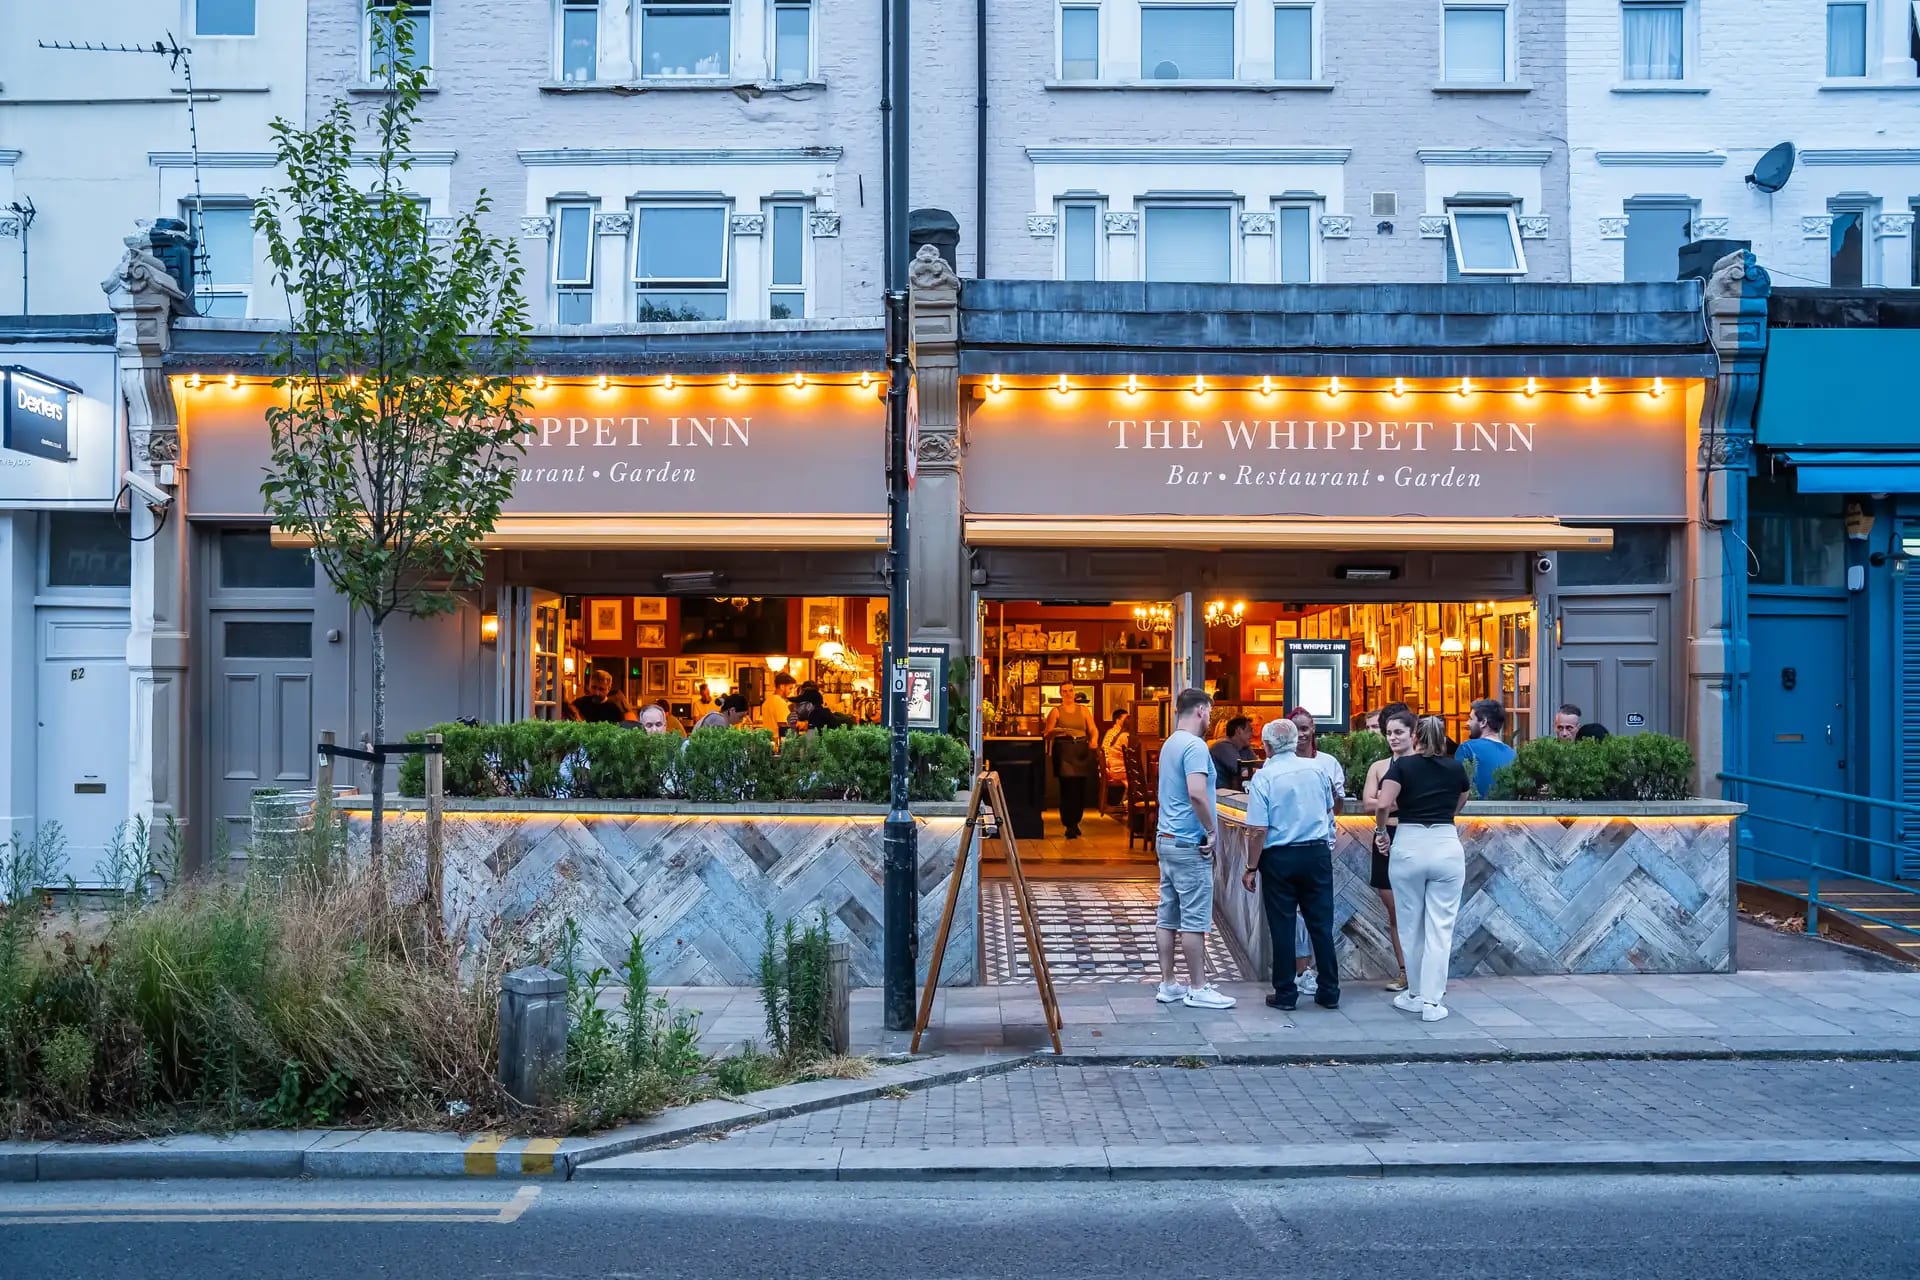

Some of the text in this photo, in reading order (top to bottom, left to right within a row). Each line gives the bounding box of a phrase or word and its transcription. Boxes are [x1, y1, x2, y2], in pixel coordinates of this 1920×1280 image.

[17, 388, 64, 422] Dexters
[667, 417, 753, 447] INN
[1107, 420, 1537, 453] THE WHIPPET INN
[609, 461, 697, 484] Garden
[1165, 464, 1482, 488] Bar Restaurant Garden
[71, 667, 85, 681] 62
